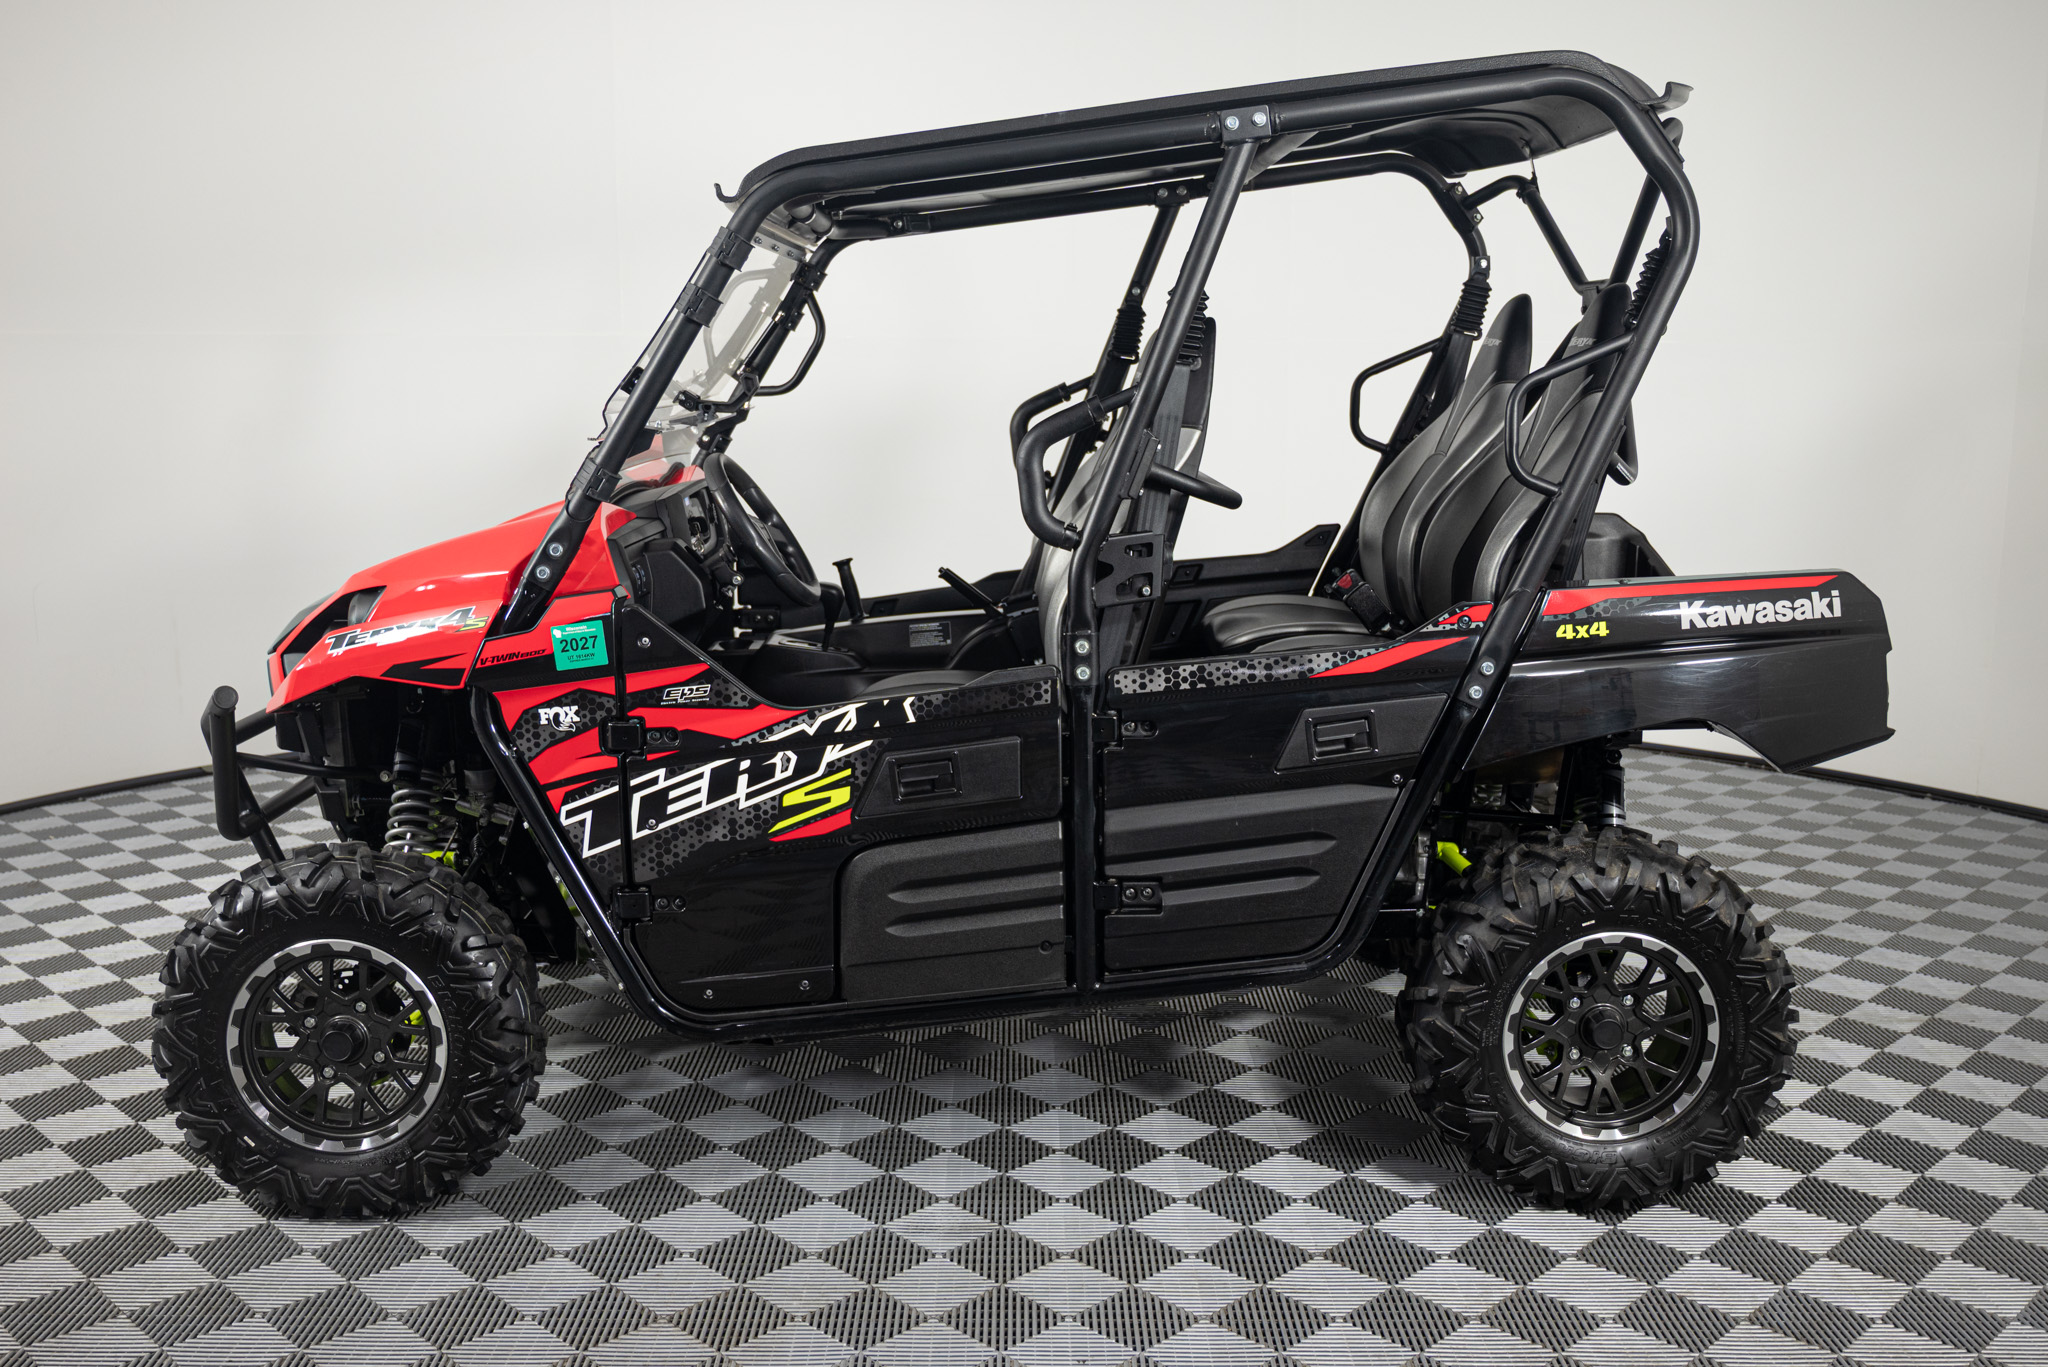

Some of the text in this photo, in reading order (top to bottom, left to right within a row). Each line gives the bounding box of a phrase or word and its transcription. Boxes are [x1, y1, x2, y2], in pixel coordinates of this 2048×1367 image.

[1679, 590, 1842, 630] Kawasaki
[1556, 621, 1610, 640] 4x4
[559, 634, 598, 653] 2027
[663, 684, 711, 701] EPS
[538, 705, 580, 732] FOX
